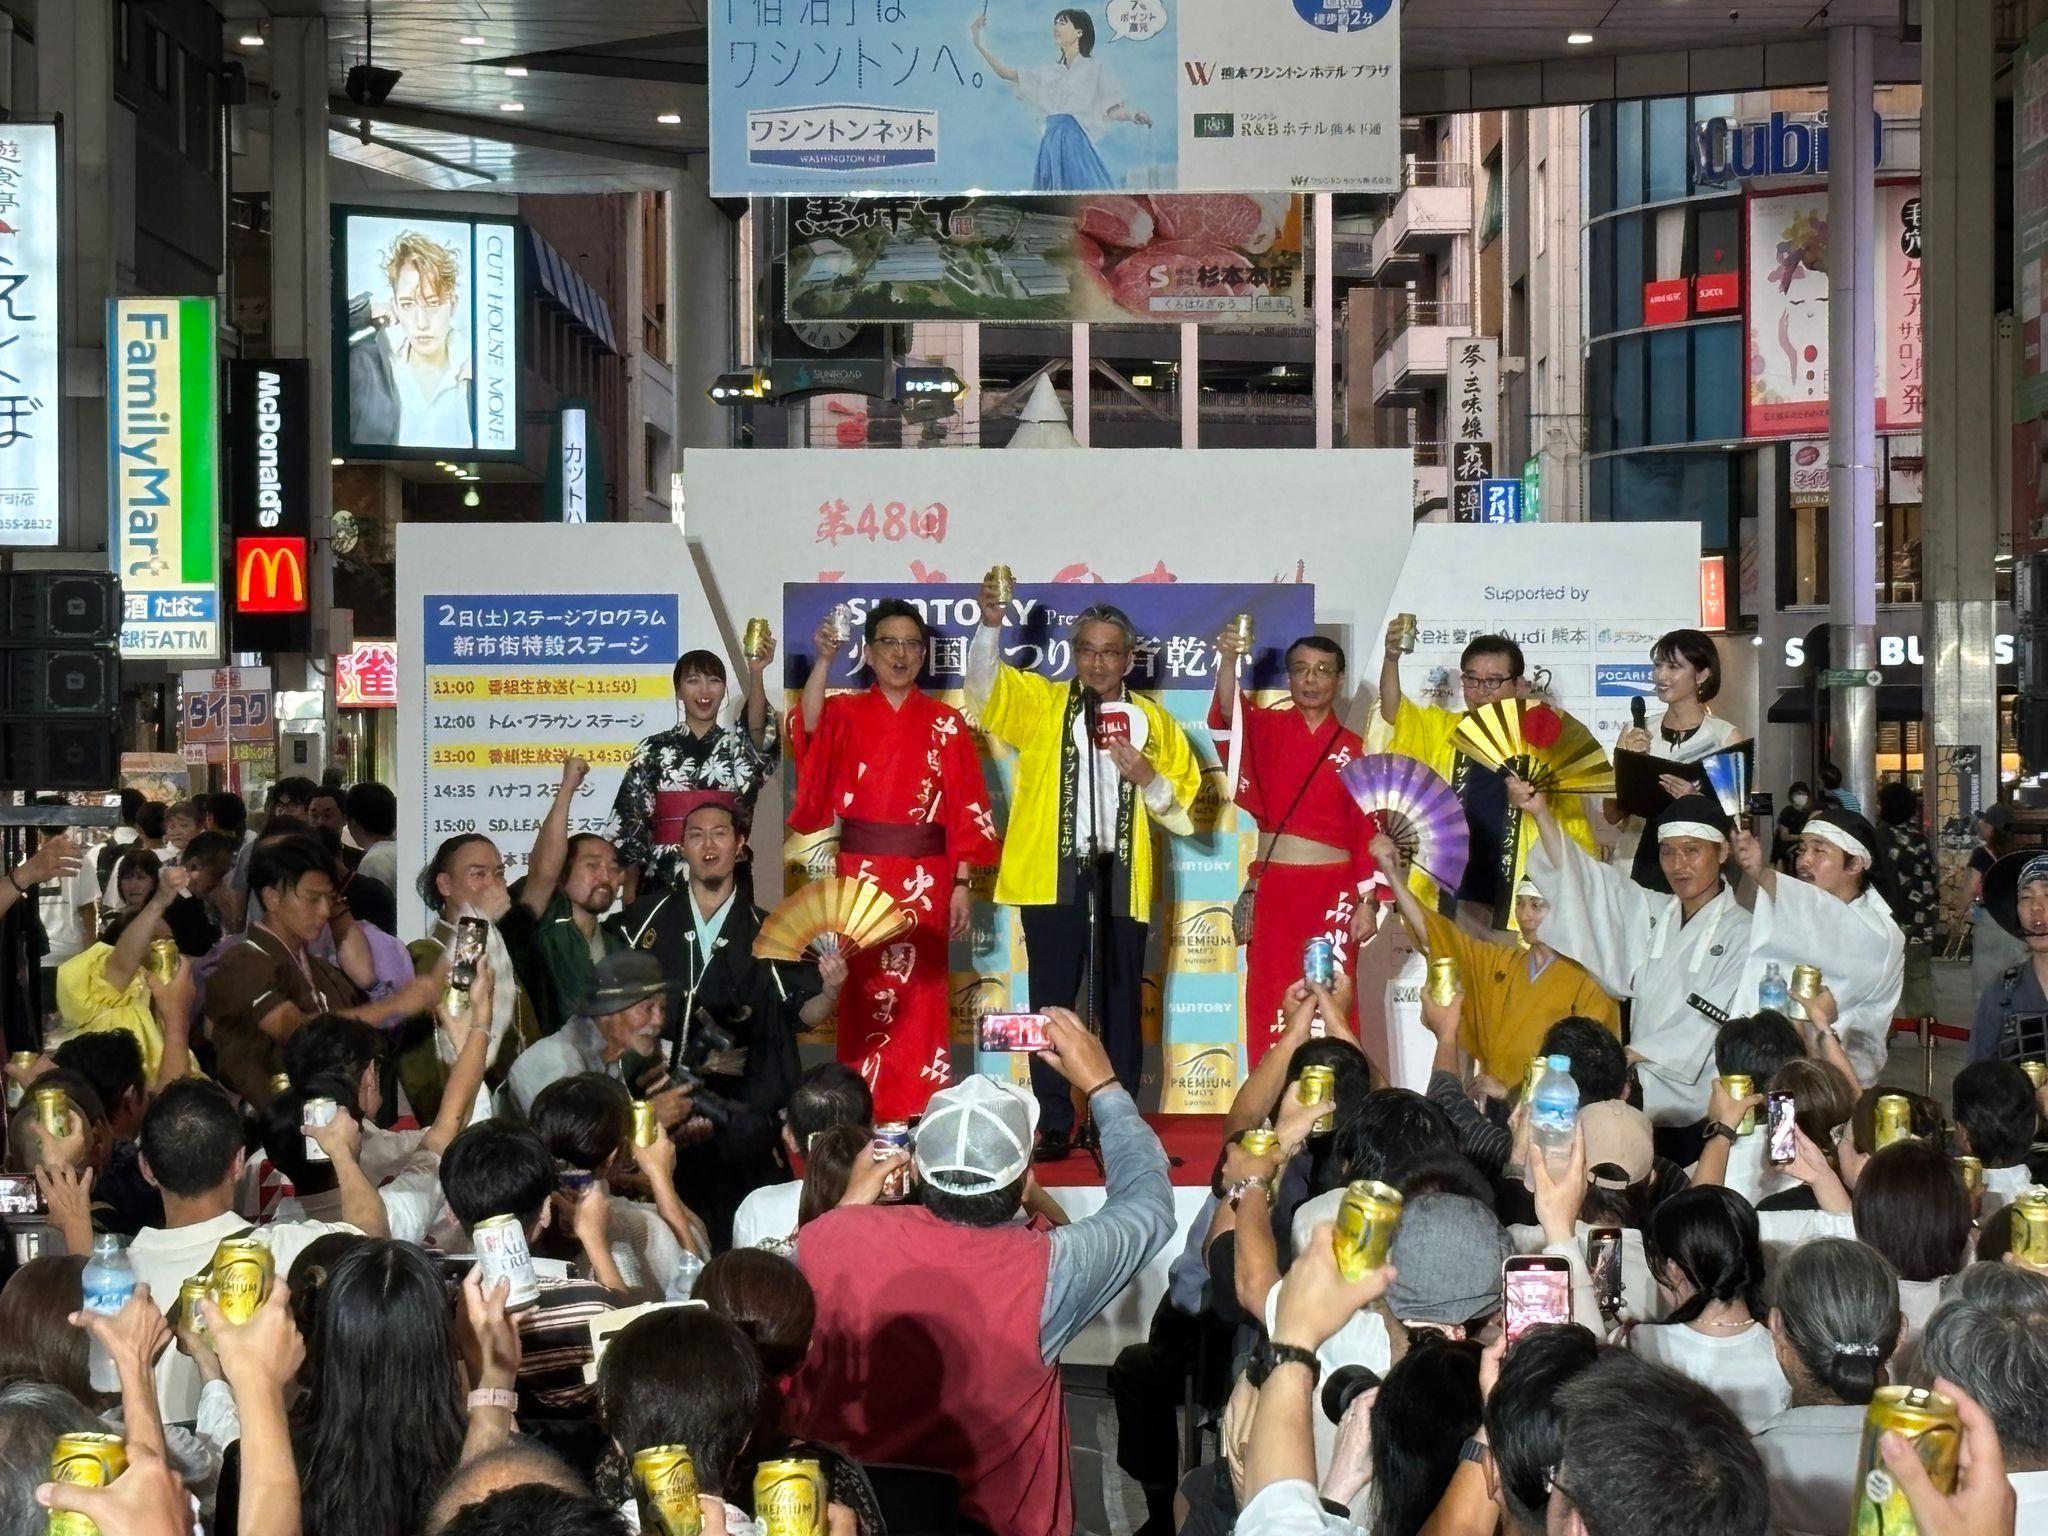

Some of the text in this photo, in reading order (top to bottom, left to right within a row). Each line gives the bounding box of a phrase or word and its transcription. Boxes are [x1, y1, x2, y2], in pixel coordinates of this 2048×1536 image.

[730, 37, 984, 88] ワシントンへ。
[1221, 65, 1348, 80] 熊本ワシントンホテル
[1352, 64, 1392, 79] プラザ
[750, 118, 934, 143] ワシントンネット
[800, 154, 887, 164] WASHINGTON NET
[487, 291, 504, 368] HOUSE
[1459, 343, 1487, 441] 琴・三味線
[488, 377, 505, 442] MORE
[119, 312, 172, 577] FamilyMart
[815, 498, 948, 547] 第48回
[1484, 586, 1590, 603] Supported by
[155, 596, 204, 618] たばこ
[438, 604, 667, 627] 2日(土)ステージプログラム
[121, 630, 208, 649] 銀行ATM
[1500, 628, 1546, 645] Audi
[1551, 627, 1587, 645] 熊本
[453, 634, 649, 657] 新市街特設ステージ
[1597, 671, 1645, 681] POCARI
[433, 681, 475, 695] 11:00
[189, 693, 267, 728] ダイコク
[433, 713, 645, 729] 12:00 トム・ブラウン ステージ
[433, 751, 476, 764] 13:00
[433, 785, 476, 798] 14:35
[488, 784, 531, 798] ハナコ
[433, 819, 476, 832] 15:00
[1187, 916, 1217, 935] The
[1171, 935, 1232, 947] PREMIUM
[1168, 1003, 1233, 1013] SUNTORY
[1186, 1059, 1216, 1077] The
[1170, 1077, 1232, 1088] PREMIUM
